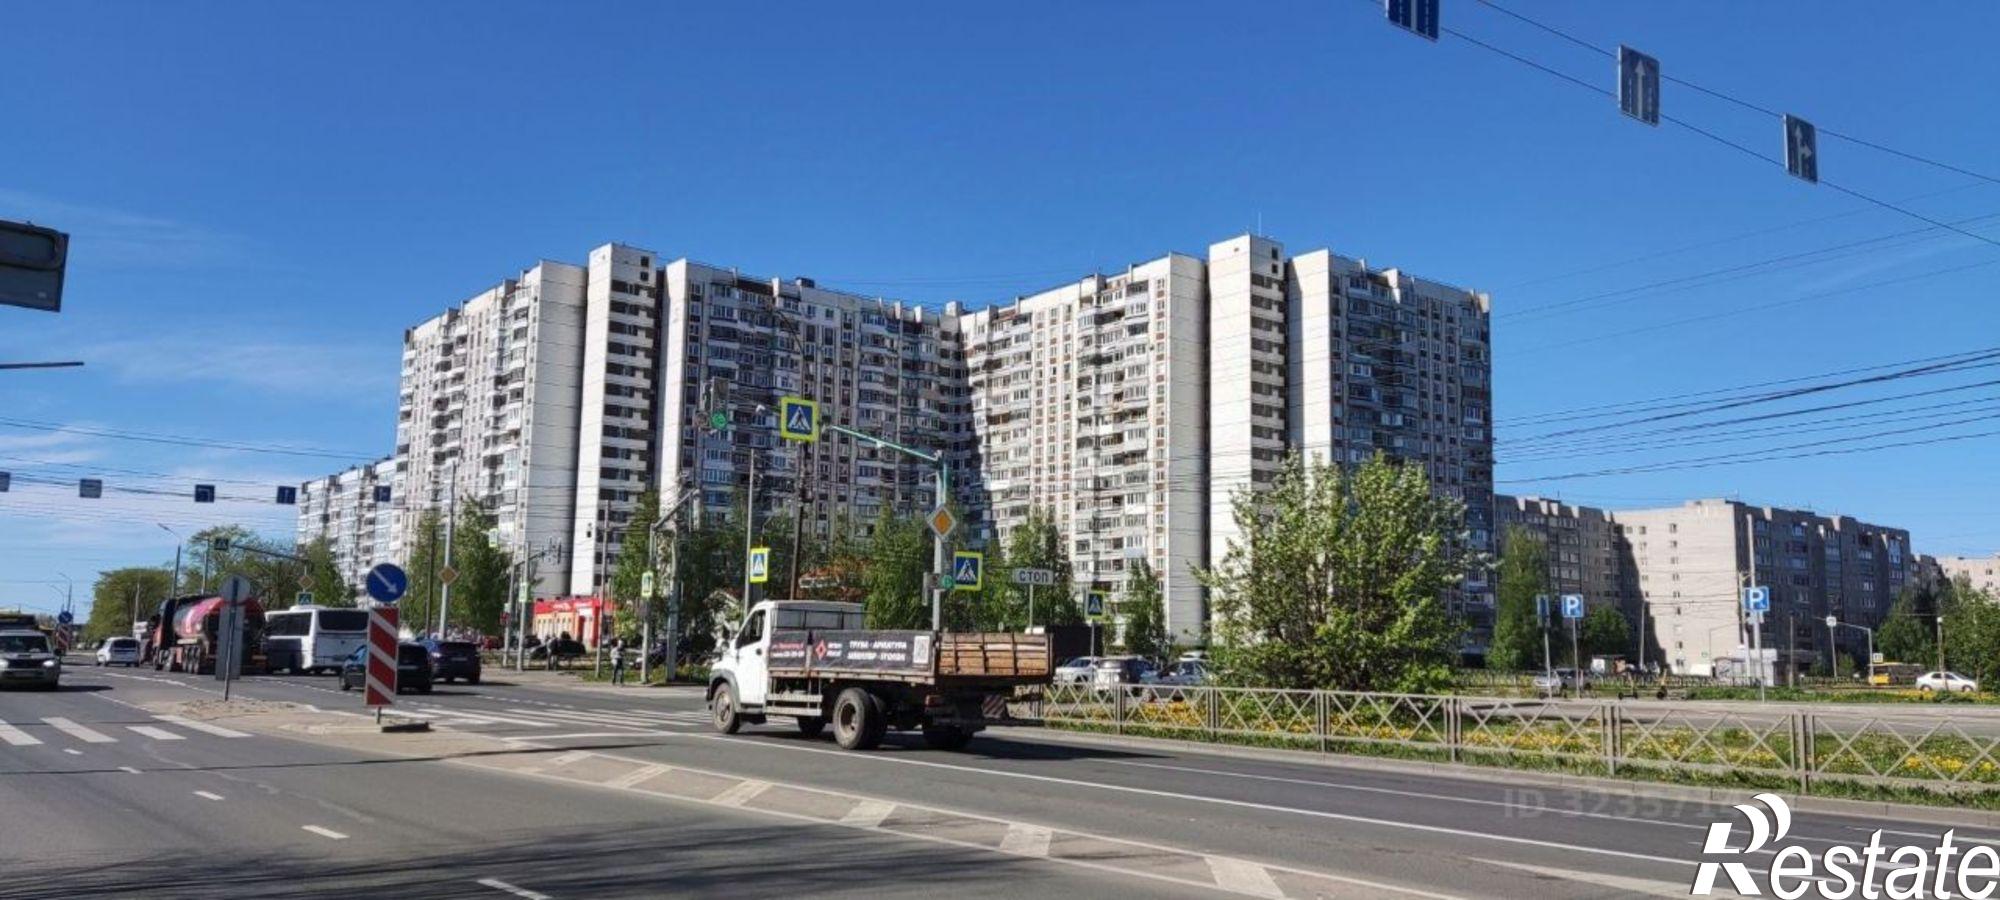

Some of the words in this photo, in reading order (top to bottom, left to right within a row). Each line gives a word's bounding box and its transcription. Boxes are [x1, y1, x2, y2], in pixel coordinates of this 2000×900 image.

[1019, 572, 1049, 583] СТОП
[1566, 596, 1579, 615] P
[1750, 589, 1764, 609] P
